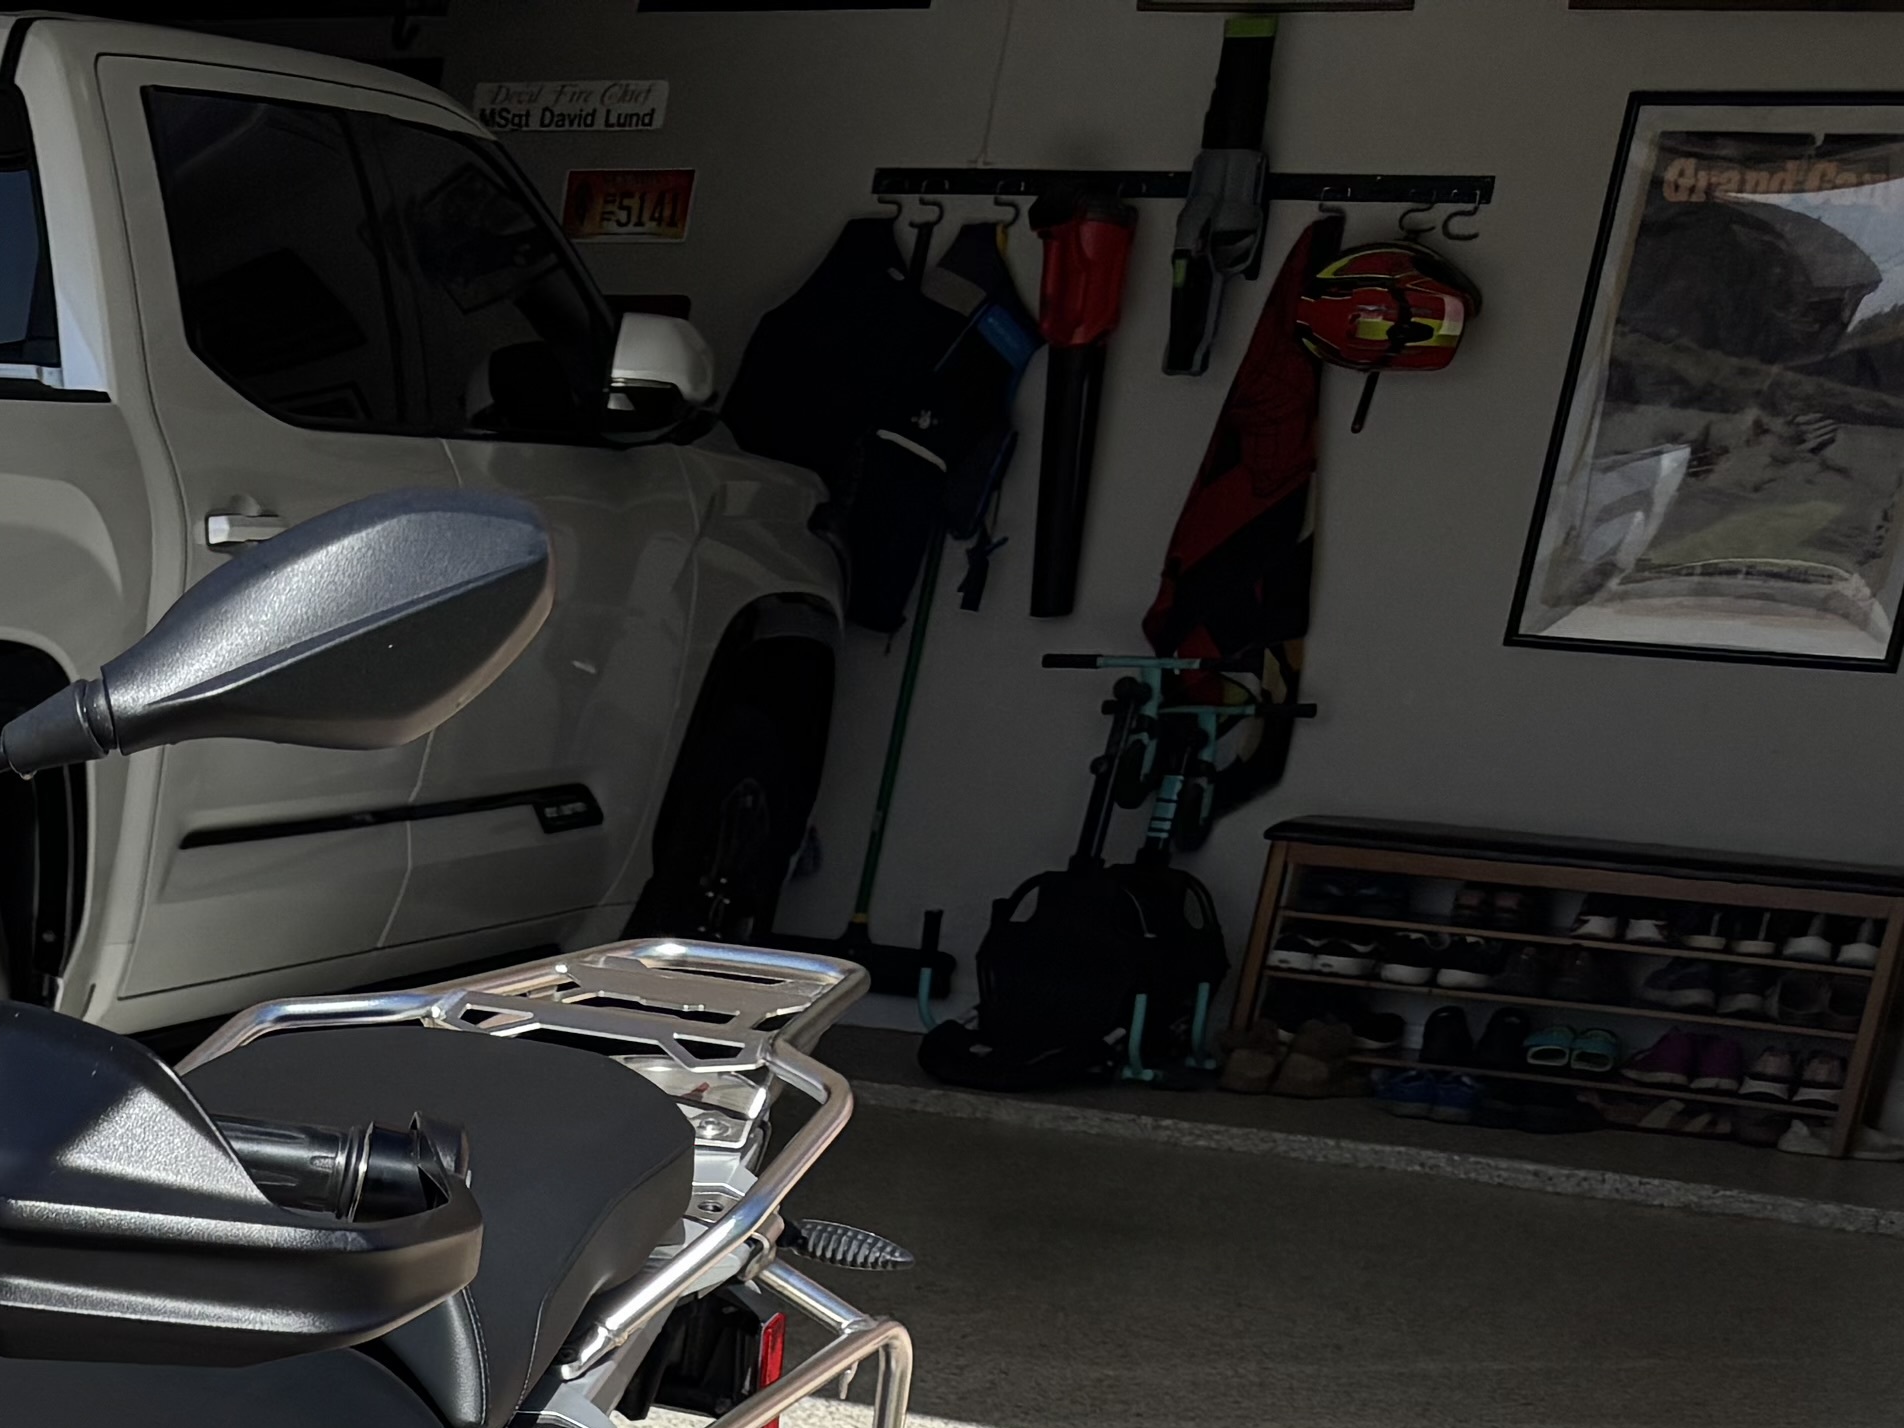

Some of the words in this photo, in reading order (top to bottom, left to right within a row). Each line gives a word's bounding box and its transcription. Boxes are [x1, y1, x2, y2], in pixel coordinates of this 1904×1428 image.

[539, 107, 596, 129] David
[604, 108, 656, 128] Lund
[1663, 157, 1801, 203] Grand
